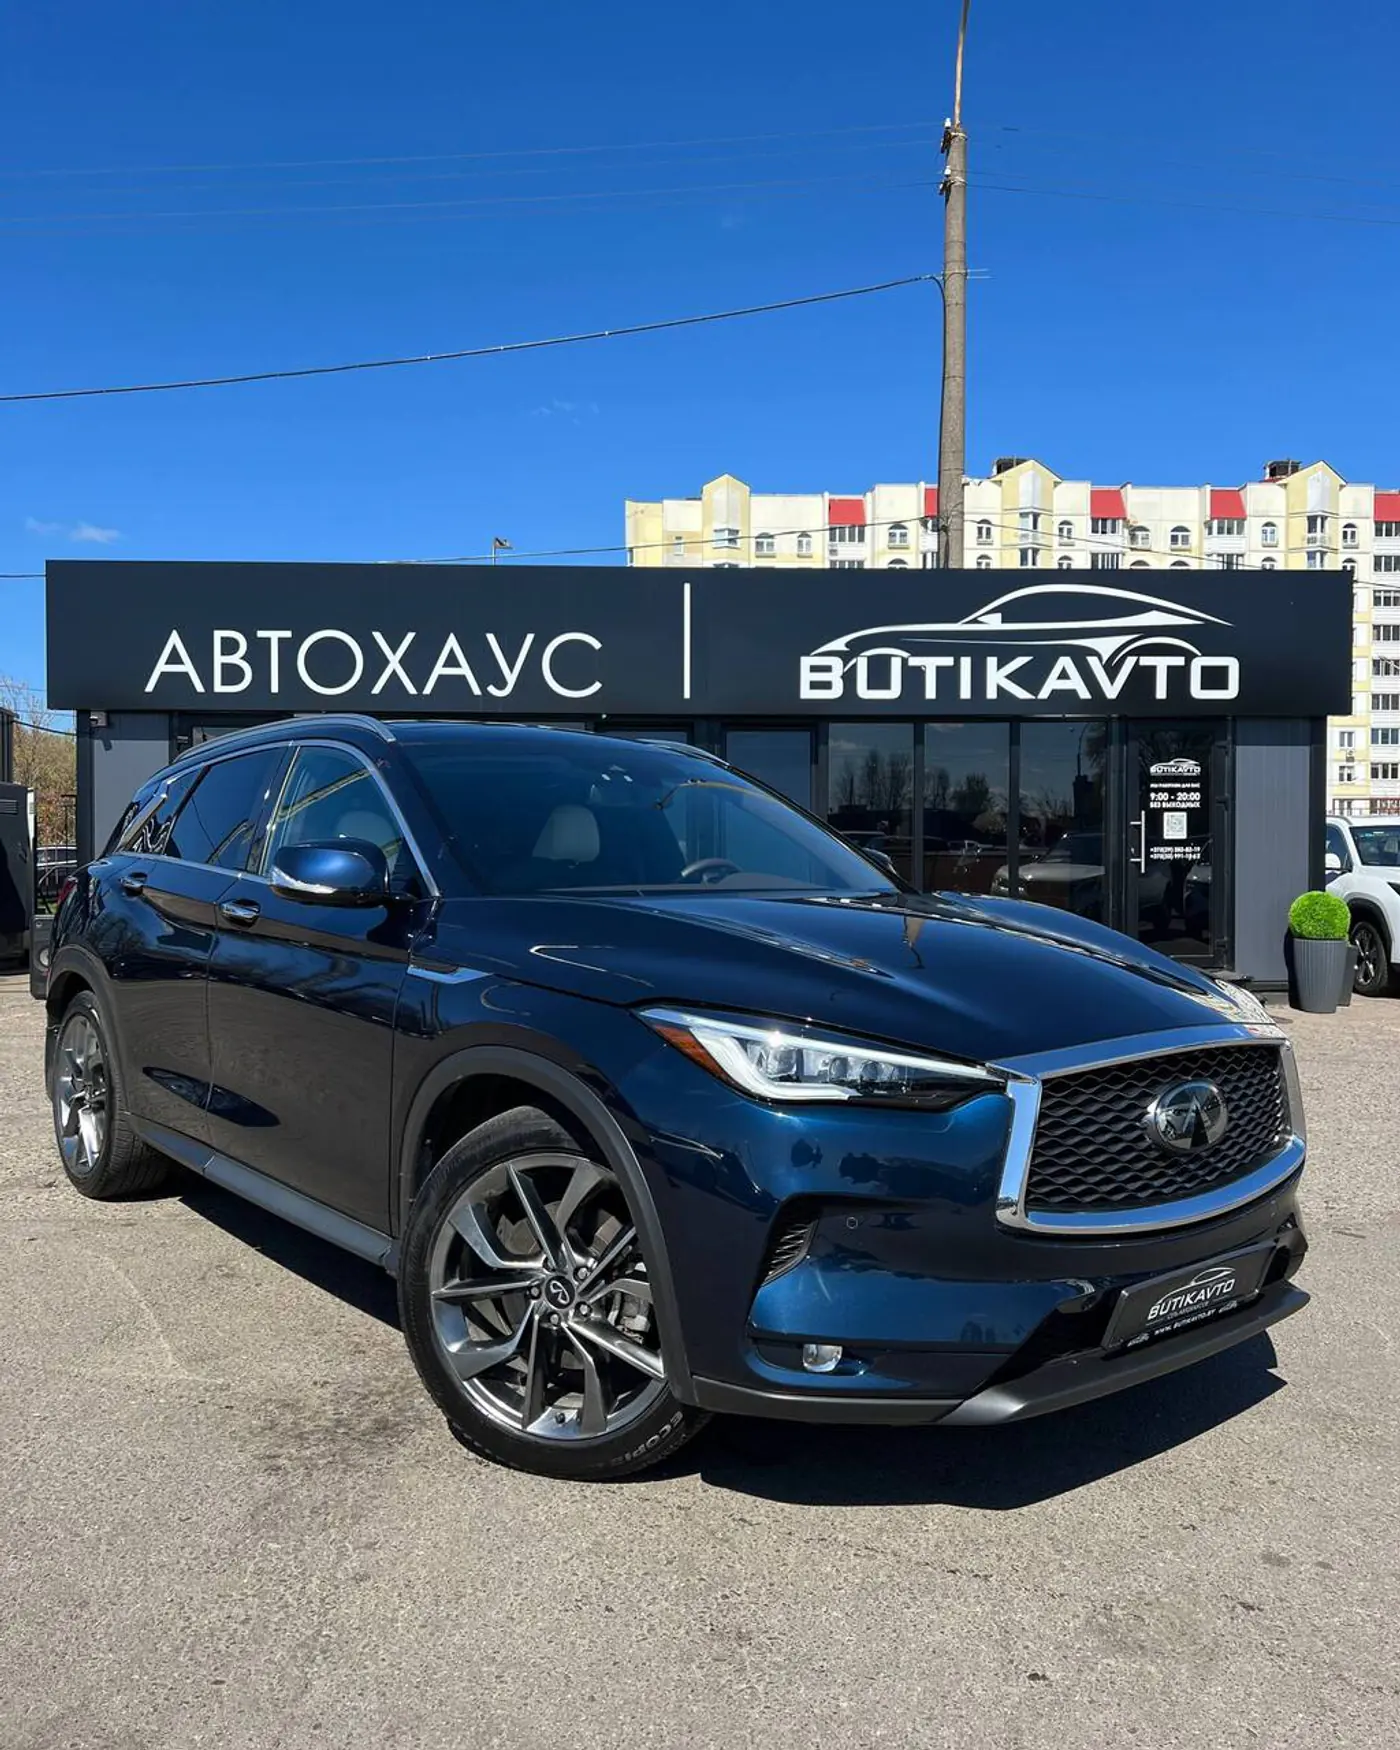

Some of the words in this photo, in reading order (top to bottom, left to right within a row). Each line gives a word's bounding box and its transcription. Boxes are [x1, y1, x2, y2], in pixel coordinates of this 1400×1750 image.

[144, 629, 603, 699] АВТОХАУС
[799, 655, 1241, 701] BUTIKAVTO
[1150, 765, 1201, 774] BUTIKAVTO
[1150, 792, 1169, 801] 9:00
[1175, 792, 1201, 801] 20:00
[1147, 1278, 1236, 1320] BUTIKAVTO
